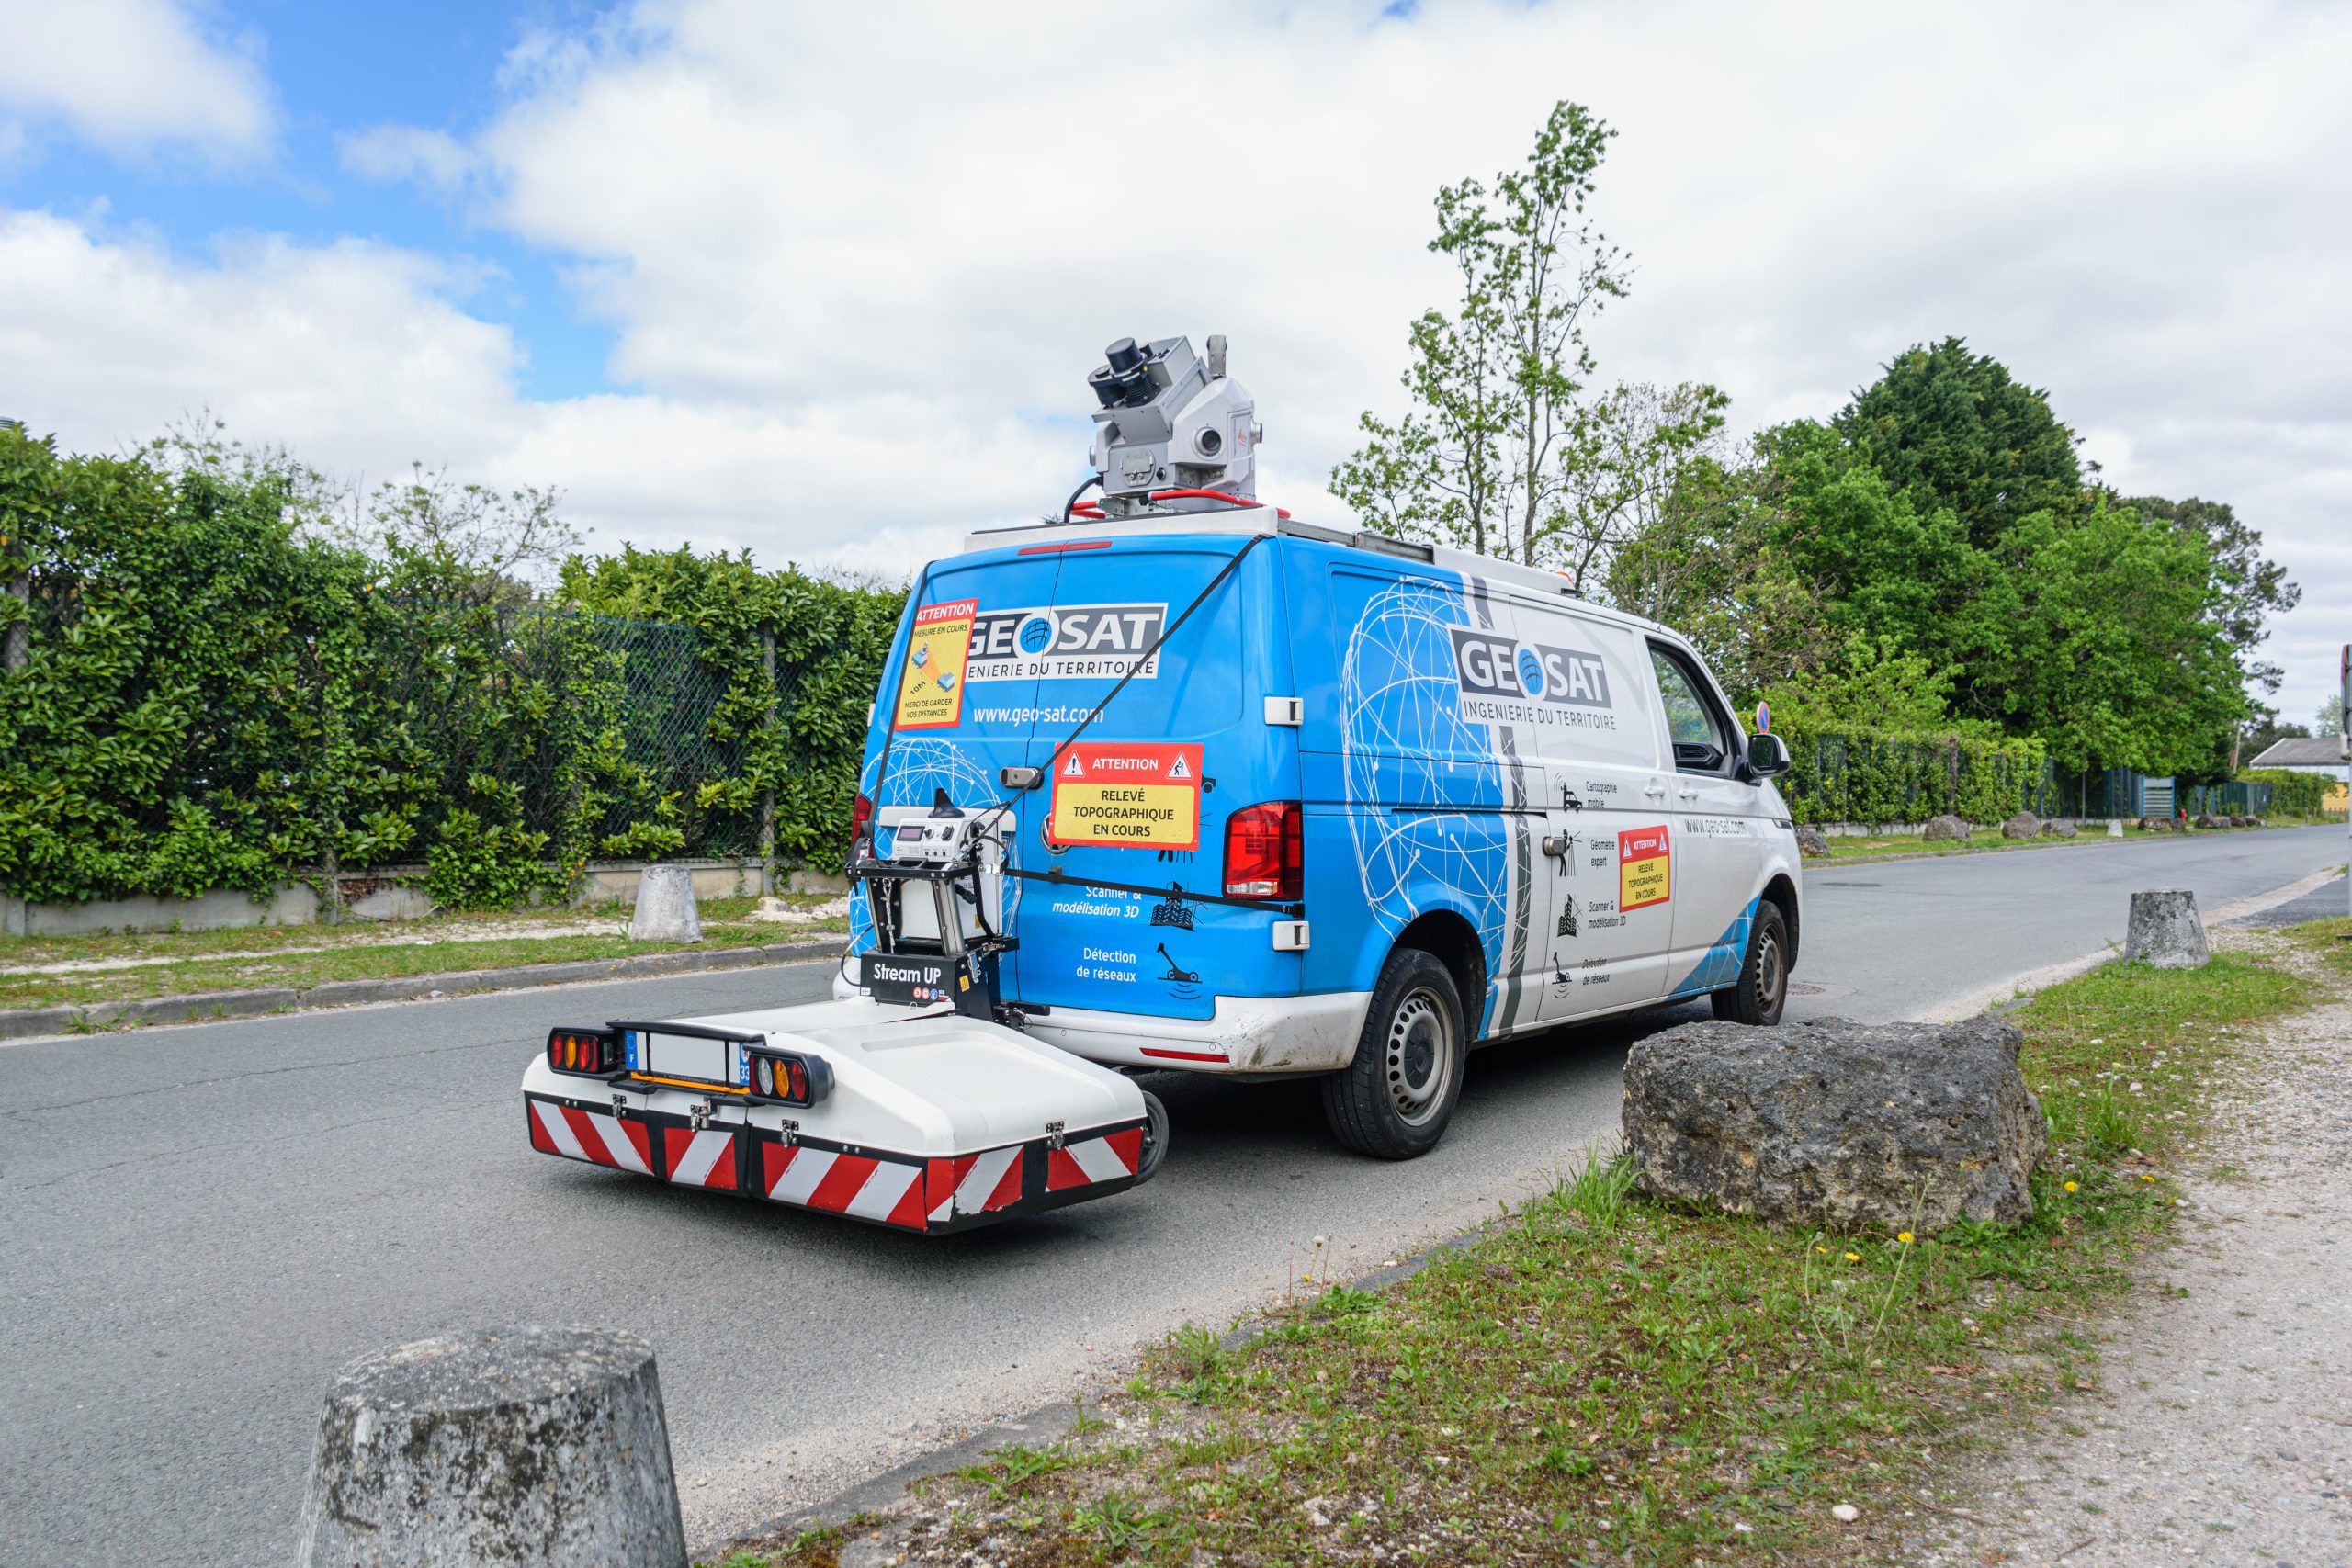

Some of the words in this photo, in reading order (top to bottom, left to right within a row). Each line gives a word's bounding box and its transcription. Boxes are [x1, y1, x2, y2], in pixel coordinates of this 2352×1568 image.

[916, 602, 975, 622] ATTENTION
[914, 627, 938, 637] MESURE
[946, 624, 968, 634] COURS
[968, 664, 1023, 678] ENIERIE
[1029, 663, 1050, 675] DU
[1461, 640, 1603, 702] GEOSAT
[910, 681, 926, 695] 10M
[905, 699, 920, 708] MERCI
[921, 699, 929, 707] DE
[929, 698, 953, 707] GARDER
[919, 709, 947, 718] DISTANCES
[973, 705, 1104, 727] www.geo-sat.com
[1464, 700, 1533, 723] INGENIERIE
[1537, 708, 1554, 724] DU
[1556, 710, 1616, 730] TERRITOIRE
[1092, 758, 1159, 770] ATTENTION
[1102, 788, 1145, 802] RELEVÉ
[1586, 781, 1617, 795] Cartographie
[1587, 798, 1604, 809] mobile
[1073, 807, 1174, 821] TOPOGRAPHIQUE
[1093, 824, 1109, 835] EN
[1112, 825, 1150, 837] COURS
[1590, 839, 1615, 851] Géomètre
[1634, 838, 1657, 852] ATTENTION
[1590, 856, 1607, 869] expert
[1628, 874, 1663, 888] TOPOGRAPHIQUE
[1635, 891, 1643, 900] EN
[1643, 887, 1657, 898] COURS
[1052, 901, 1121, 917] modélisation
[1124, 905, 1139, 918] 3D
[1589, 900, 1609, 912] Scanner
[1588, 917, 1619, 929] modélisation
[1620, 915, 1626, 927] 3D
[1083, 947, 1136, 964] Détection
[874, 963, 920, 983] Stream
[924, 966, 942, 985] UP
[1076, 964, 1090, 977] de
[1093, 966, 1136, 983] réseaux
[1583, 975, 1590, 985] de
[1590, 973, 1610, 985] réseaux
[629, 1054, 635, 1063] F
[740, 1065, 750, 1081] 33
